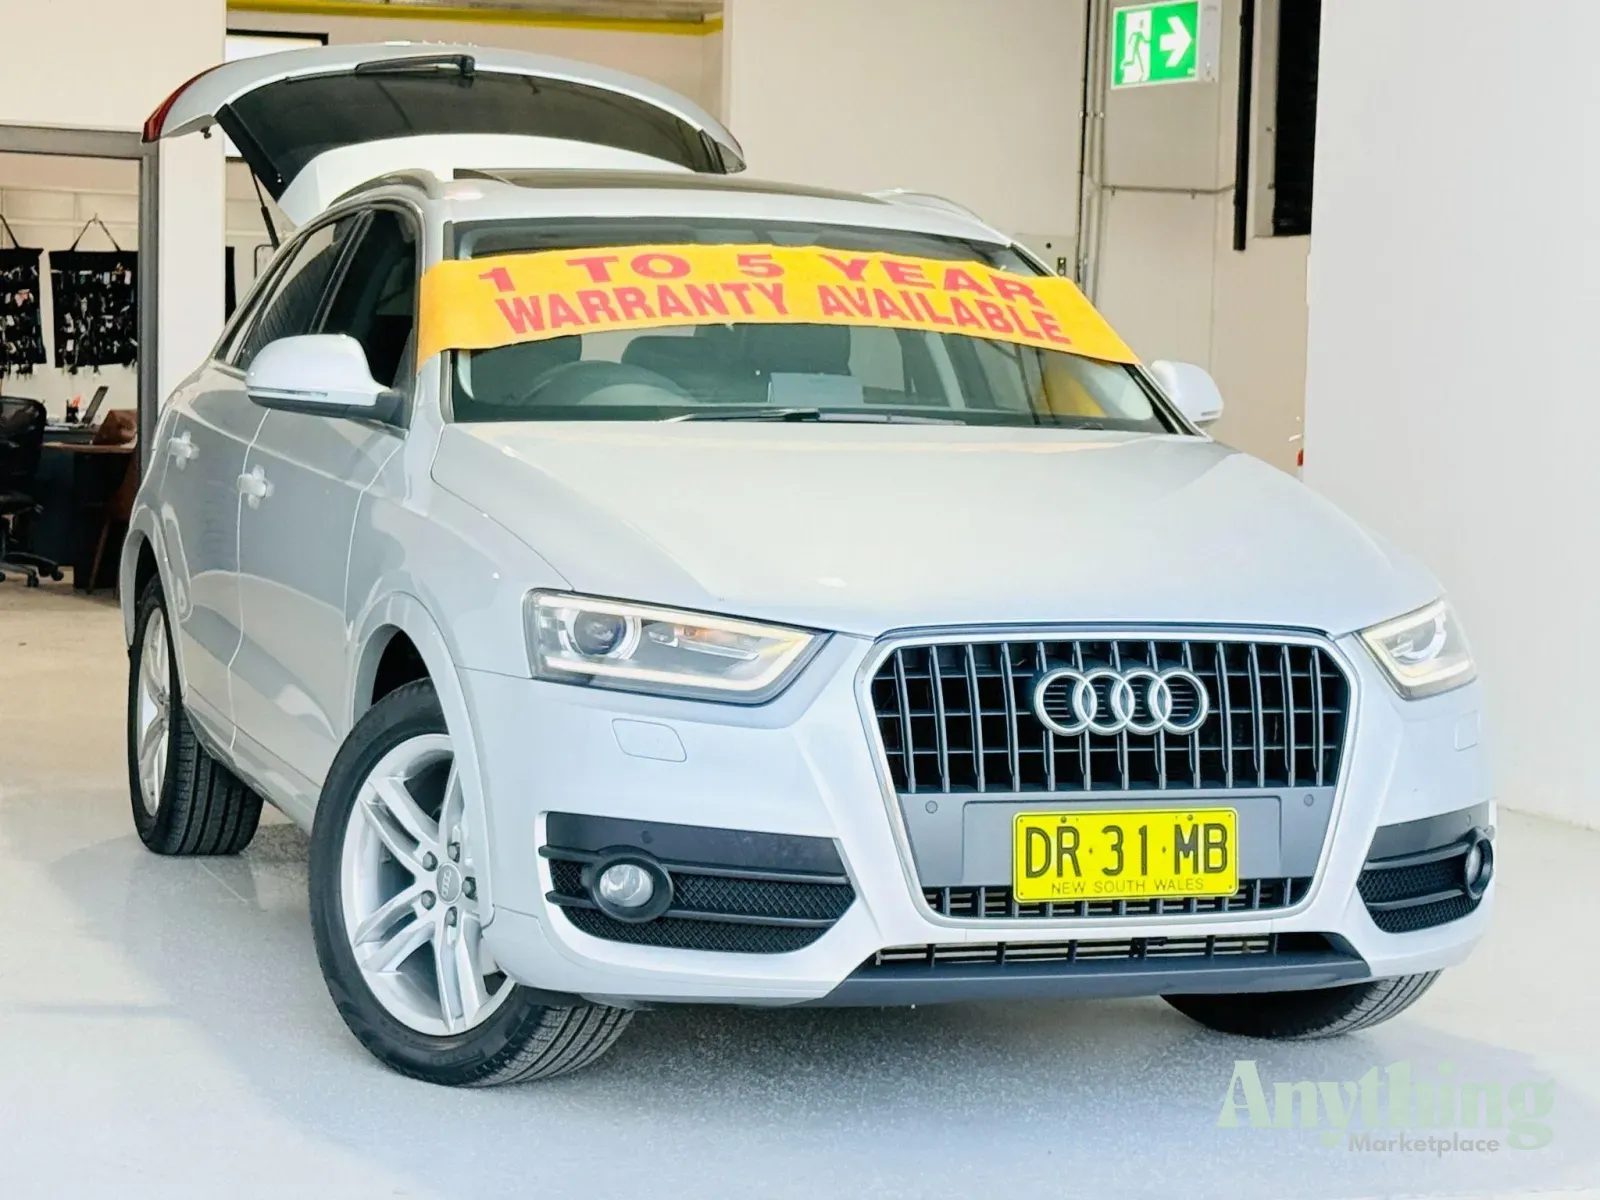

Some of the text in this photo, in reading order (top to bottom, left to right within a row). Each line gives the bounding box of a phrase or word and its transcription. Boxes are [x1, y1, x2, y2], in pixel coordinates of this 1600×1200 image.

[478, 254, 1046, 309] 1 TO 5 YEAR
[495, 283, 1072, 344] WARRANTY AVAILABLE
[1051, 878, 1205, 895] NEW SOUTH WALES
